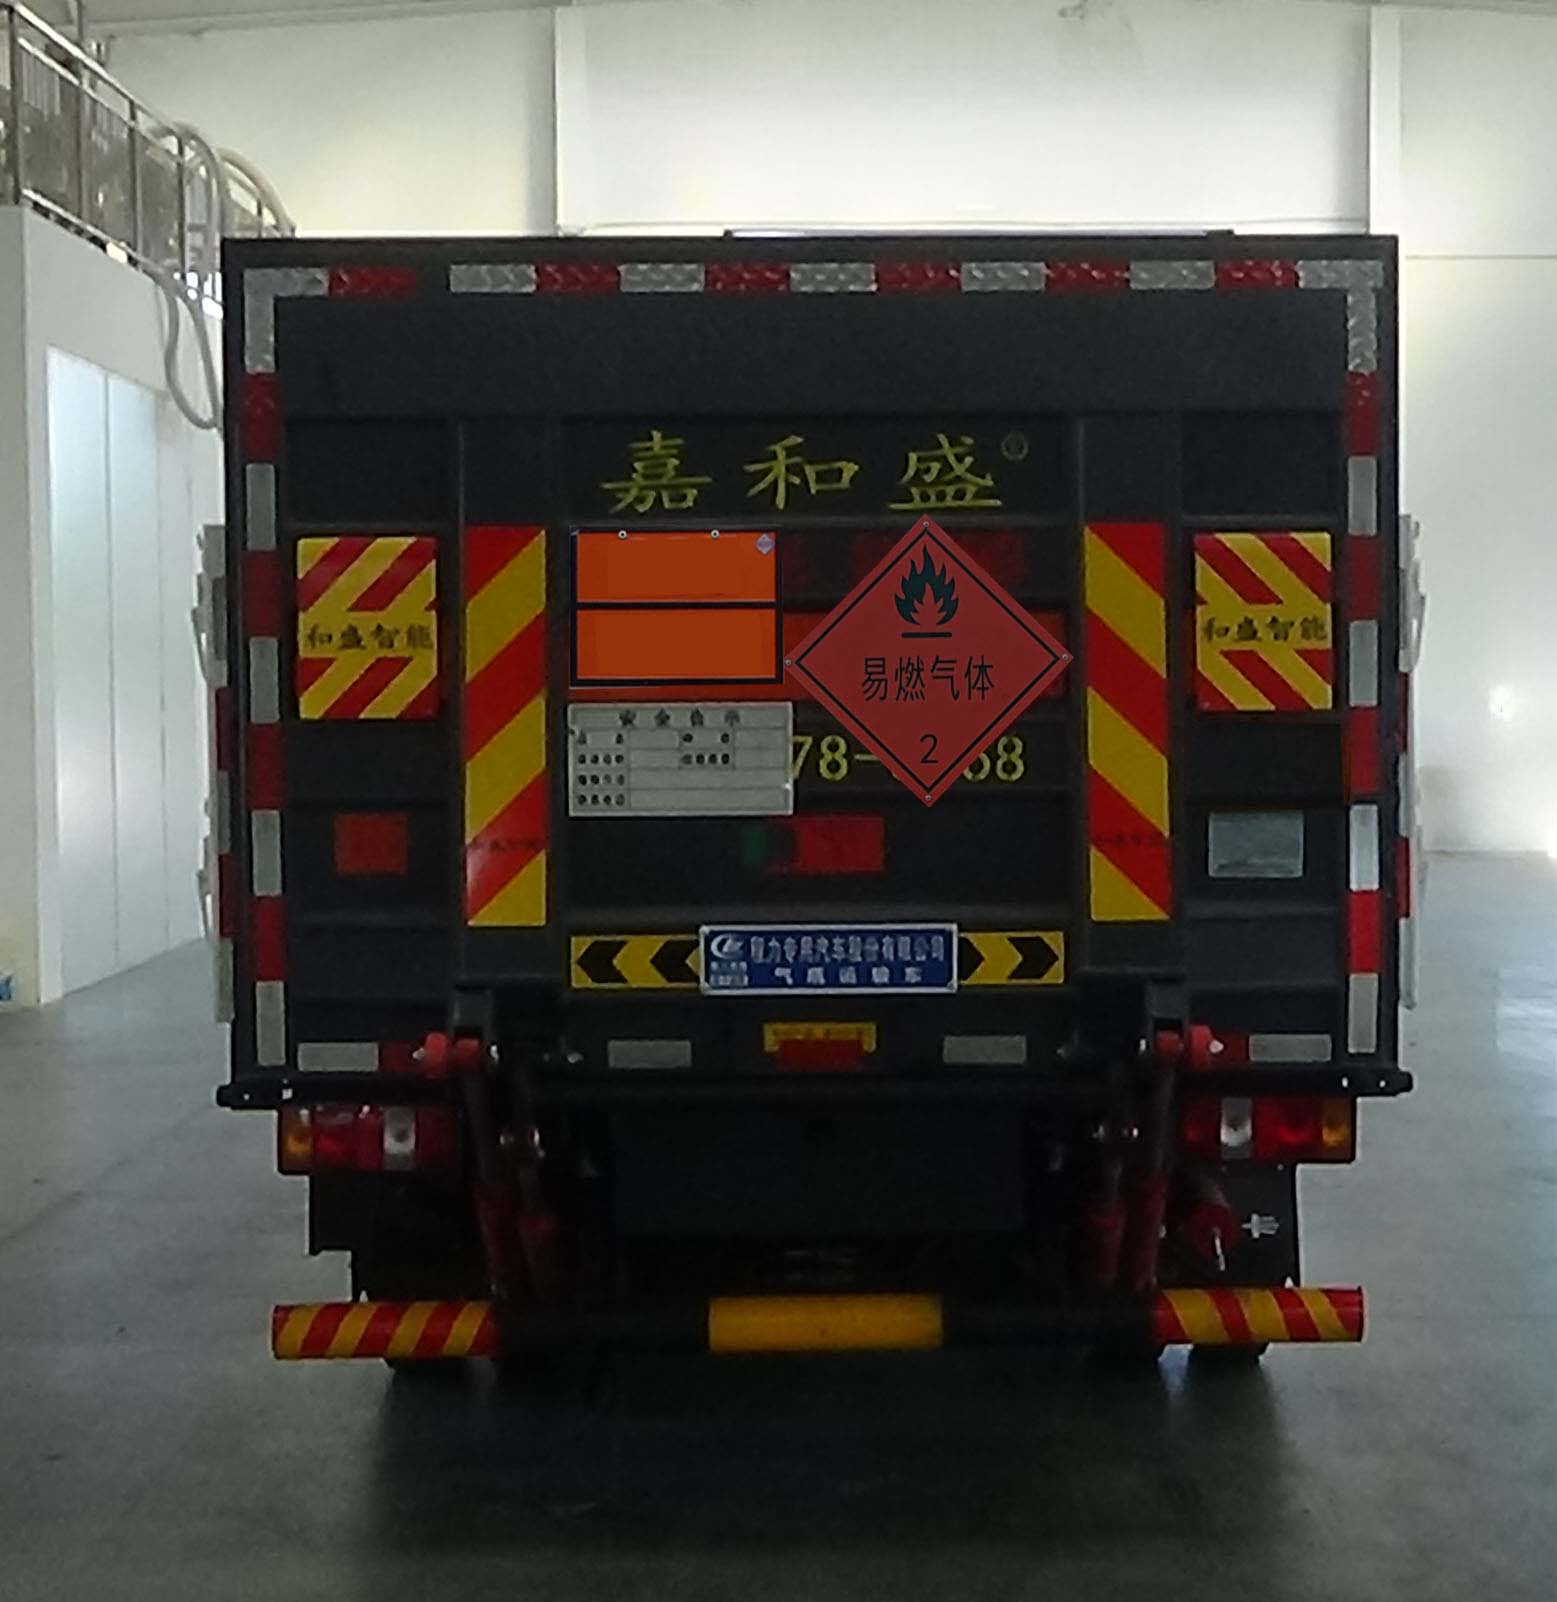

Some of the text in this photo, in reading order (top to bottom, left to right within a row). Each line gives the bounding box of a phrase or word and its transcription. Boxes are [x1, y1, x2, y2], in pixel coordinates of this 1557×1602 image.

[601, 430, 1002, 512] 嘉和盛
[306, 624, 433, 650] 和盛智能
[1202, 616, 1328, 643] 和盛智能
[862, 655, 995, 702] 易燃气体
[920, 734, 939, 764] 2
